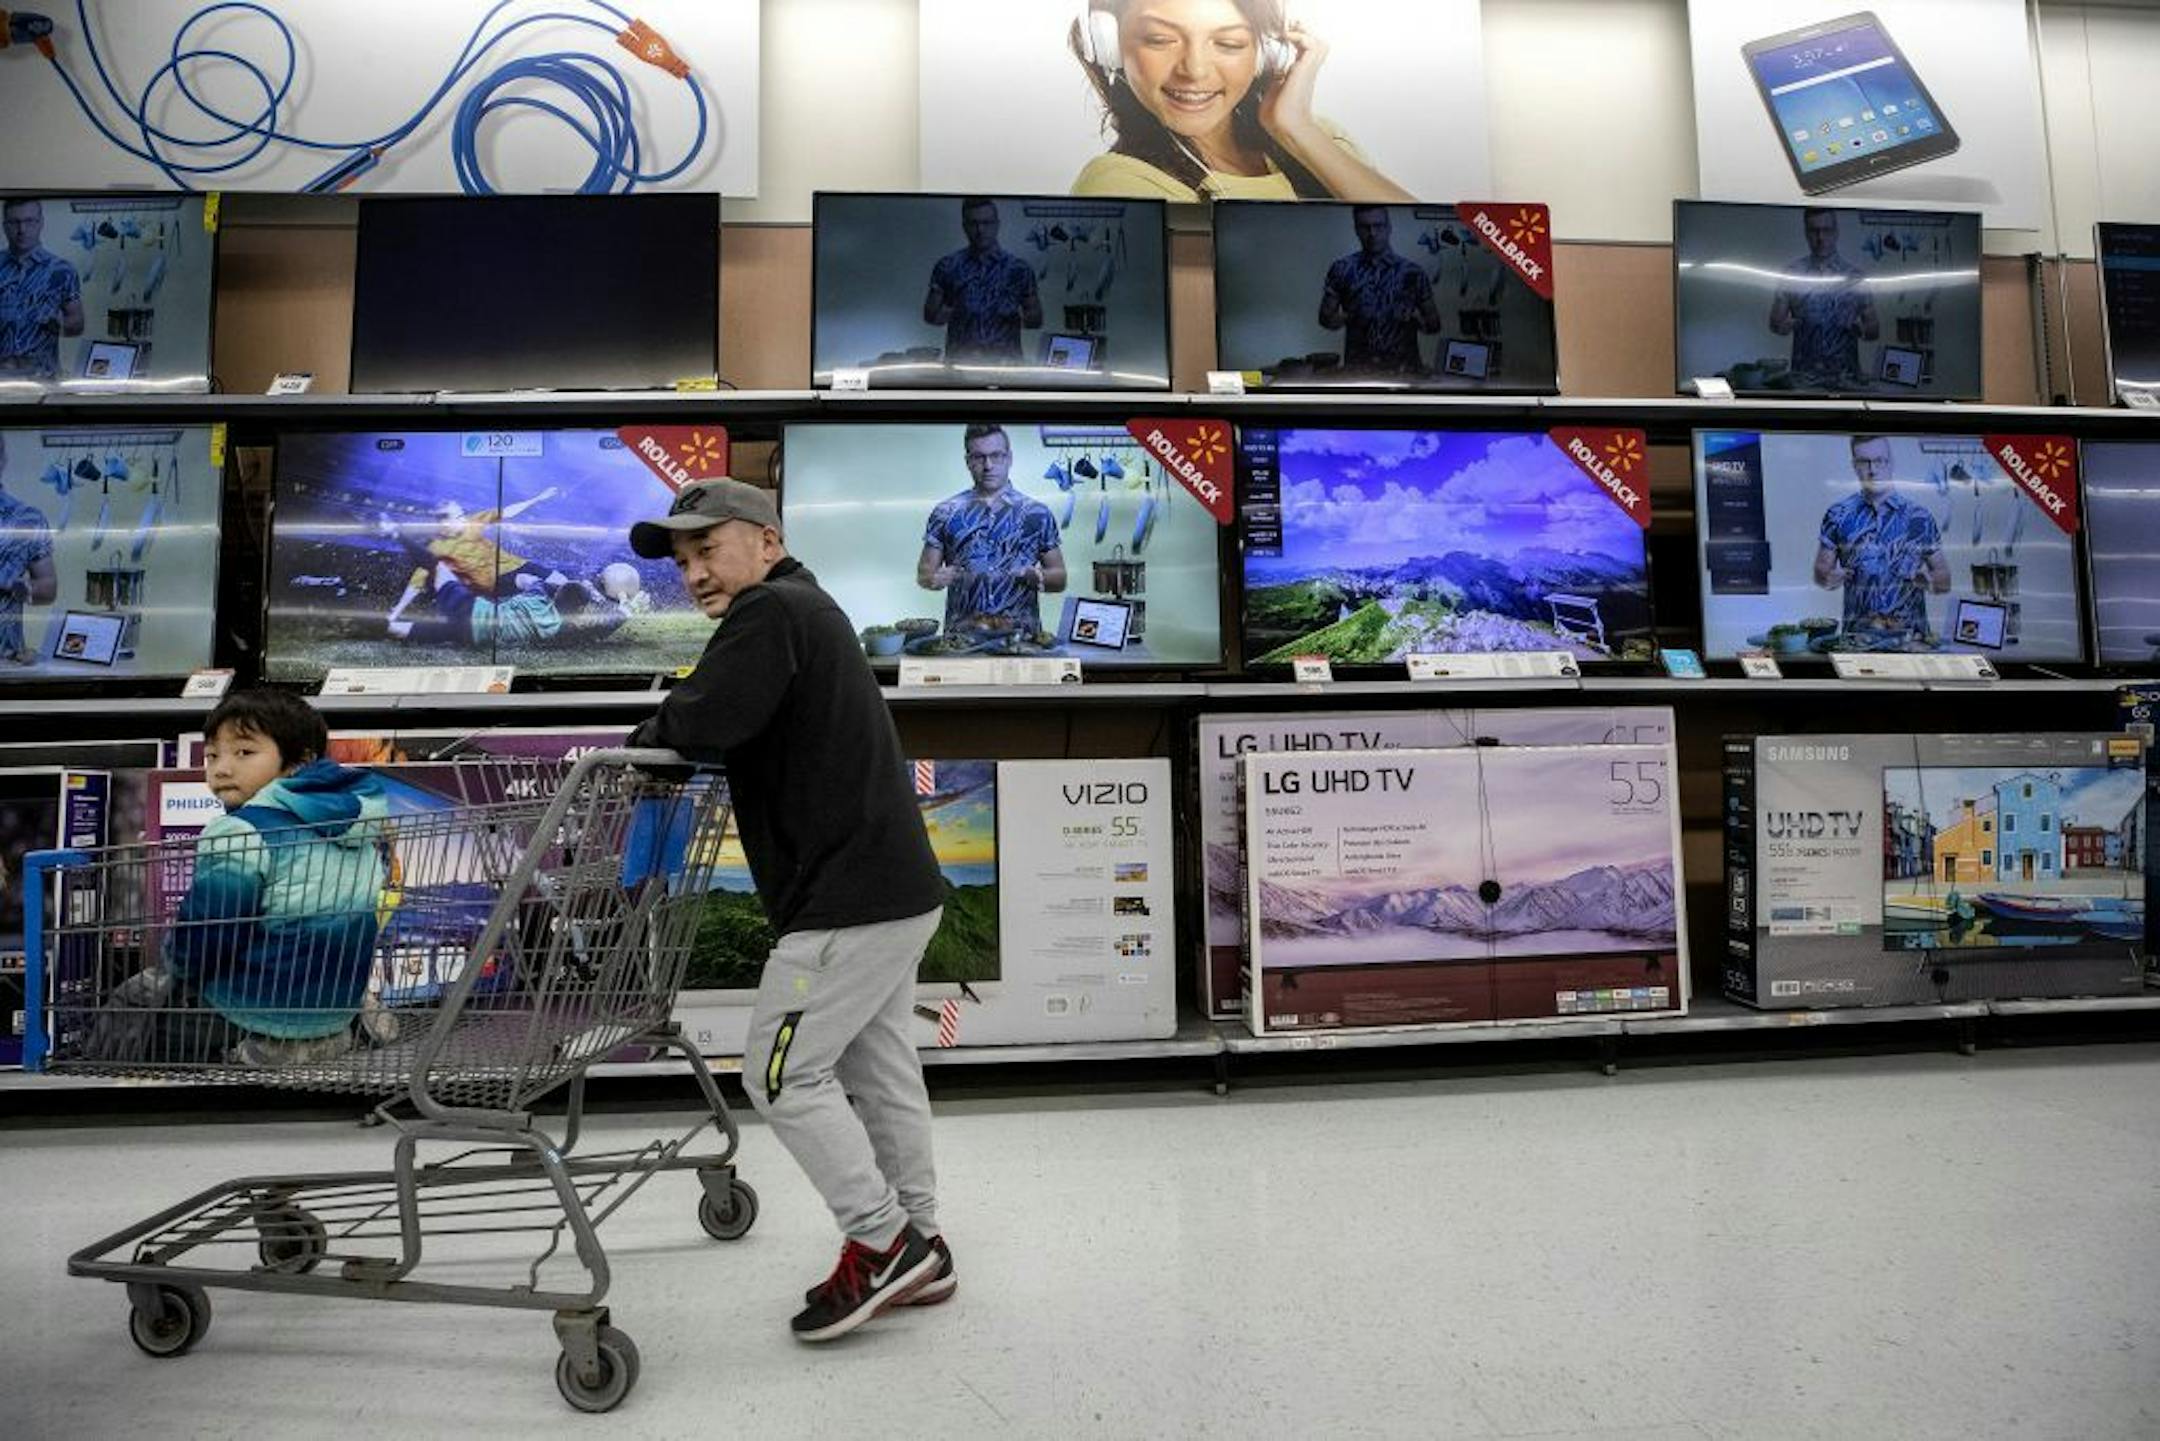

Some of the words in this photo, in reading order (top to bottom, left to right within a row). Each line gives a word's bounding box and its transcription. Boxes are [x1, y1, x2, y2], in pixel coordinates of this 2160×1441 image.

[1472, 210, 1544, 281] ROLLBACK
[488, 434, 513, 447] 120
[638, 436, 694, 488] ROLLB
[1146, 429, 1222, 504] ROLLBACK
[1568, 437, 1640, 510] ROLLBACK
[2000, 444, 2067, 515] ROLLBACK
[1219, 734, 1257, 759] LG
[1340, 732, 1381, 750] TV
[1768, 746, 1850, 761] SAMSUNG
[1063, 782, 1147, 805] VIZIO
[1265, 771, 1300, 794] LG
[1312, 770, 1370, 793] UHD
[1376, 768, 1414, 792] TV
[167, 797, 222, 810] PHILIPS
[1767, 812, 1825, 838] UHD
[1828, 811, 1863, 836] TV
